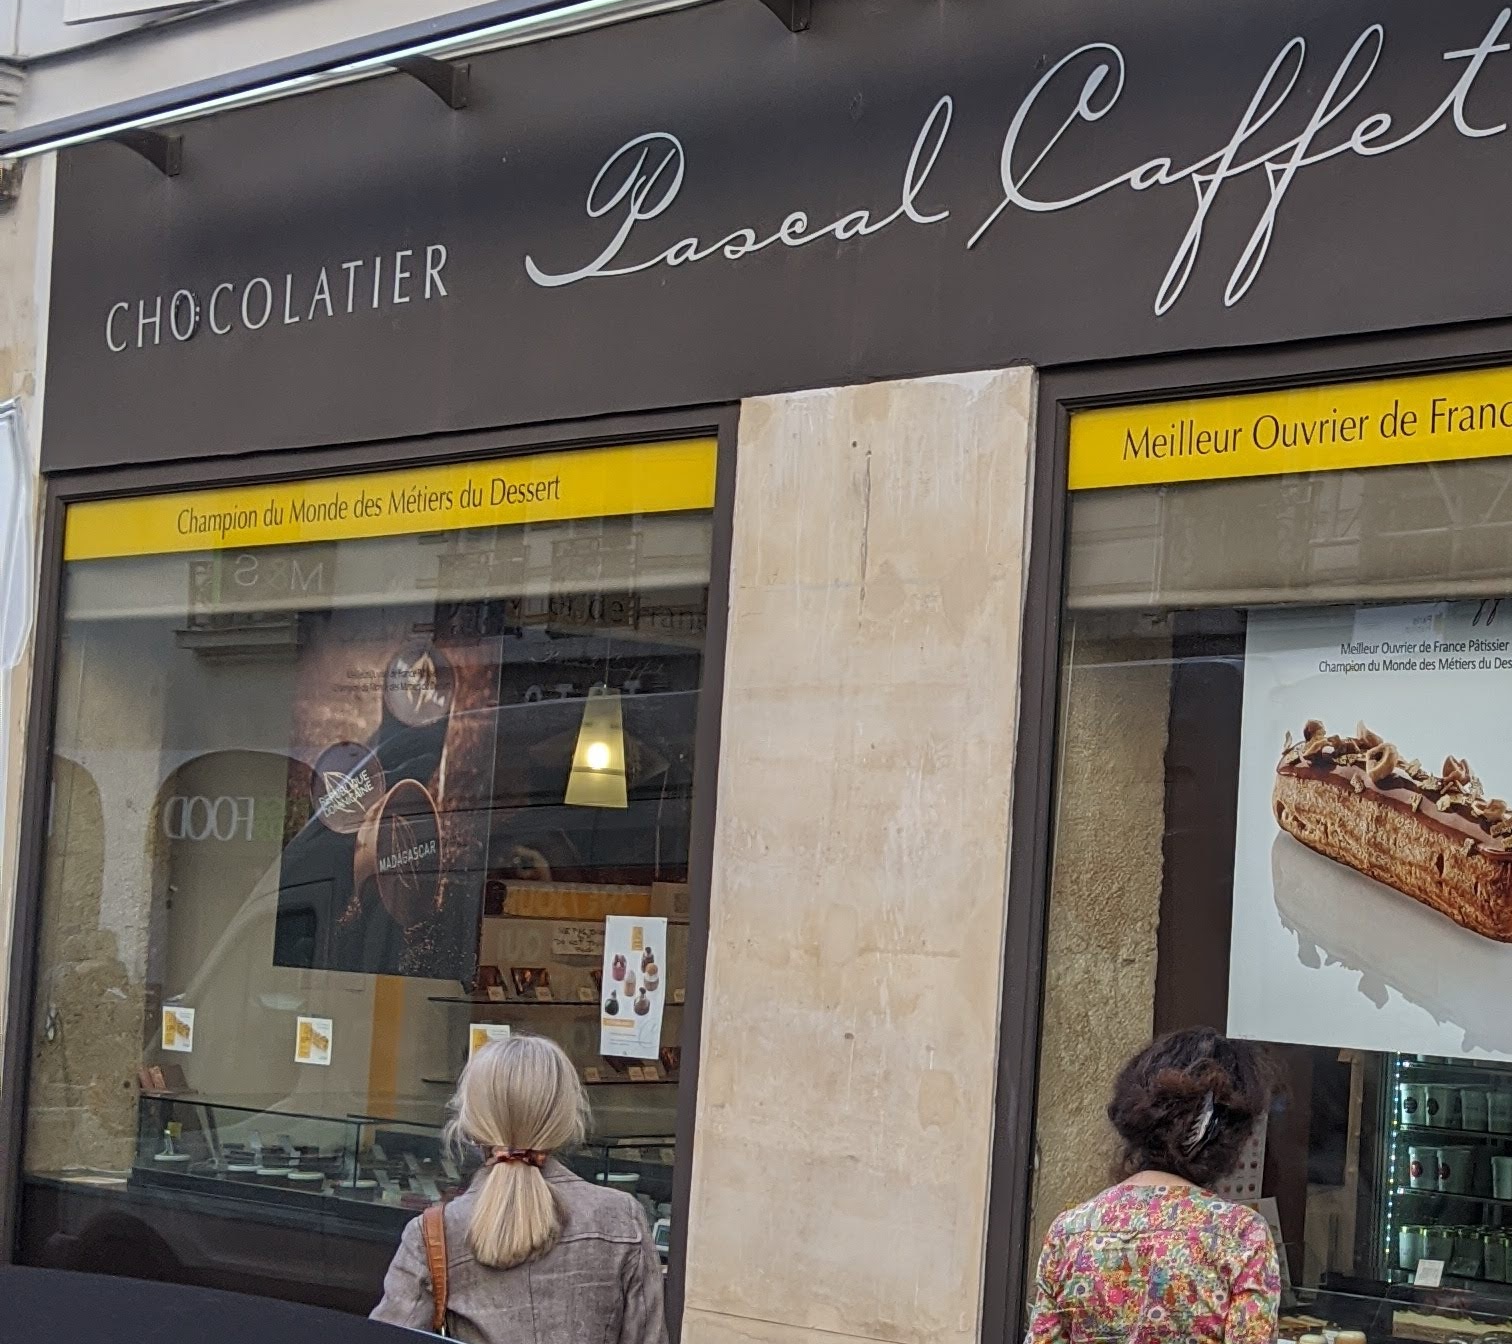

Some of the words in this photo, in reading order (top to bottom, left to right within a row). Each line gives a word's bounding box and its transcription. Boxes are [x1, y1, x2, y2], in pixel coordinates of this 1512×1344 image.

[525, 93, 954, 287] Pascal
[966, 6, 1511, 316] Caffet
[105, 243, 449, 353] CHOCOLATIER
[1122, 419, 1243, 461] Meilleur
[1252, 408, 1370, 450] Ouvrier
[1380, 399, 1418, 439] de
[177, 508, 258, 539] Champion
[263, 499, 284, 527] du
[289, 492, 348, 523] Monde
[353, 490, 383, 518] des
[388, 485, 453, 515] Métiers
[459, 479, 483, 509] du
[490, 475, 561, 506] Dessert
[1318, 660, 1366, 675] Champion
[1367, 659, 1381, 672] du
[1382, 658, 1418, 672] Monde
[1419, 658, 1436, 671] des
[1438, 656, 1477, 671] Métiers
[1478, 656, 1492, 670] du
[1340, 642, 1379, 656] Meilleur
[1381, 642, 1417, 654] Ouvrier
[1419, 641, 1432, 653] de
[1433, 641, 1467, 653] France
[1468, 638, 1510, 653] Pâtissier
[379, 840, 437, 873] MADAGASCAR
